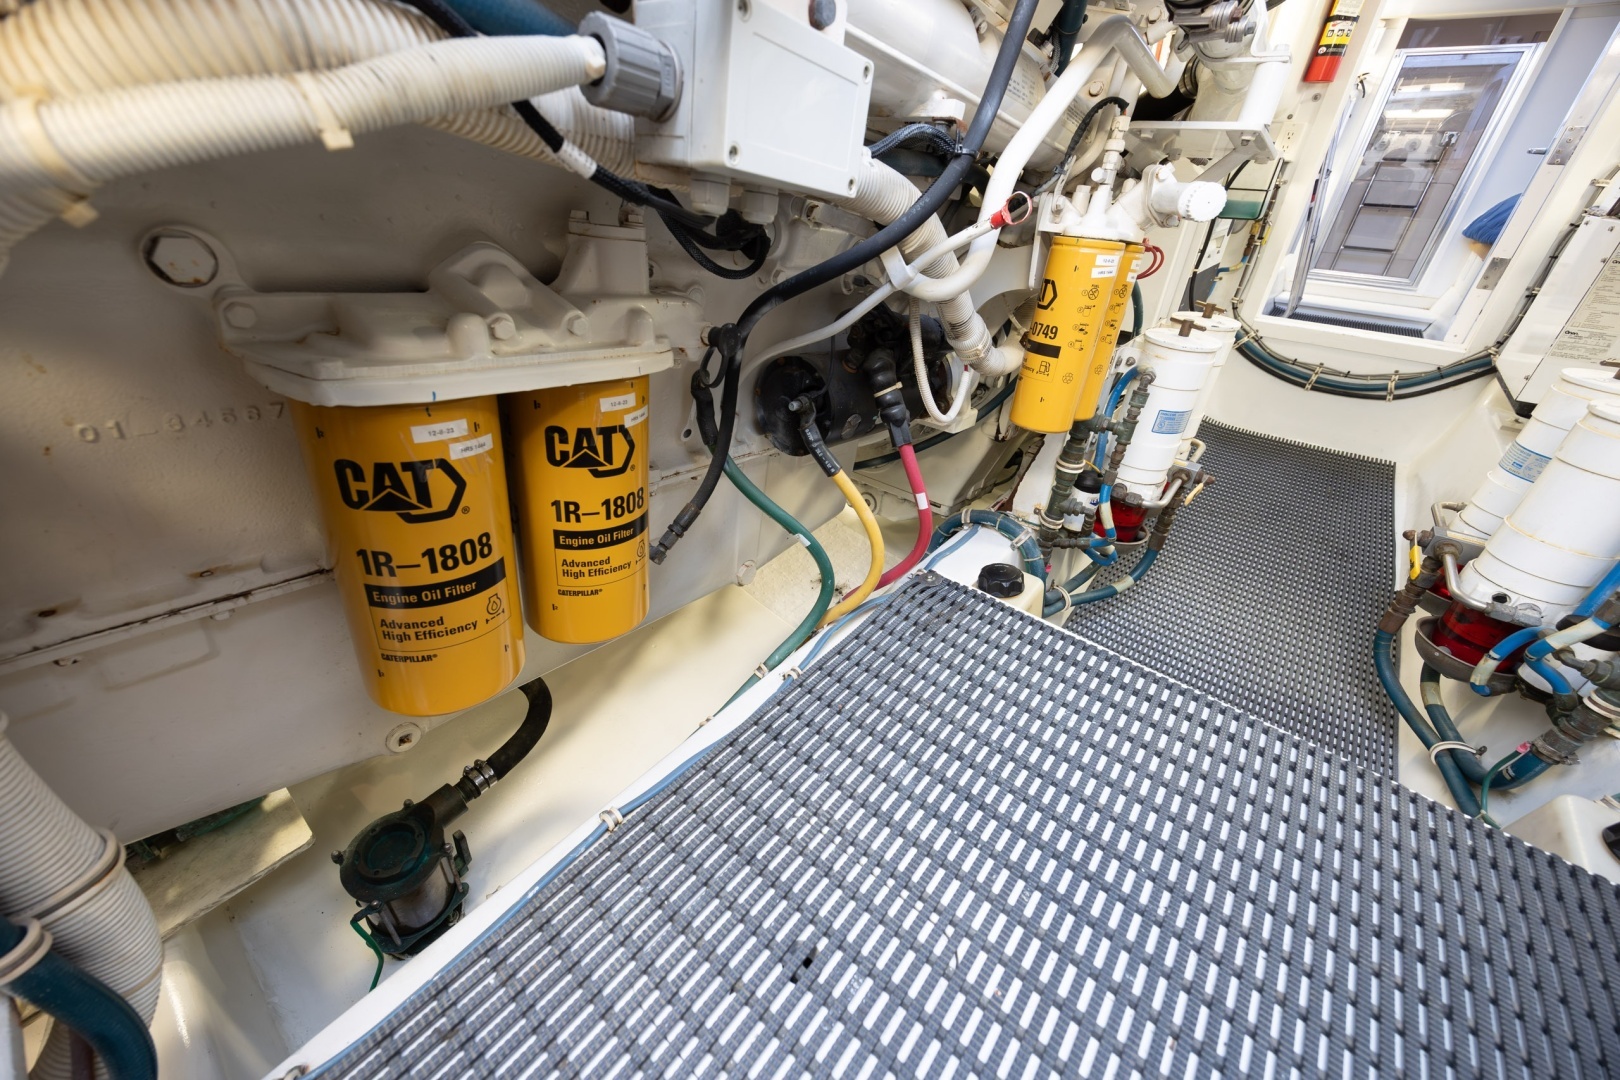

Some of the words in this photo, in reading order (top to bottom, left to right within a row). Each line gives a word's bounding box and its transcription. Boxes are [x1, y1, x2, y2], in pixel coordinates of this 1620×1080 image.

[544, 425, 618, 468] CAT
[334, 458, 433, 511] CAT
[559, 535, 595, 547] Engine
[597, 534, 611, 544] Oil
[613, 527, 634, 540] Filter
[561, 556, 611, 568] Advanced
[562, 569, 585, 579] High
[588, 561, 632, 577] Efficiency
[372, 591, 418, 605] Engine
[421, 590, 441, 602] Oil
[444, 581, 477, 598] Filter
[380, 616, 444, 630] Advanced
[382, 630, 411, 643] High
[415, 620, 478, 641] Efficiency
